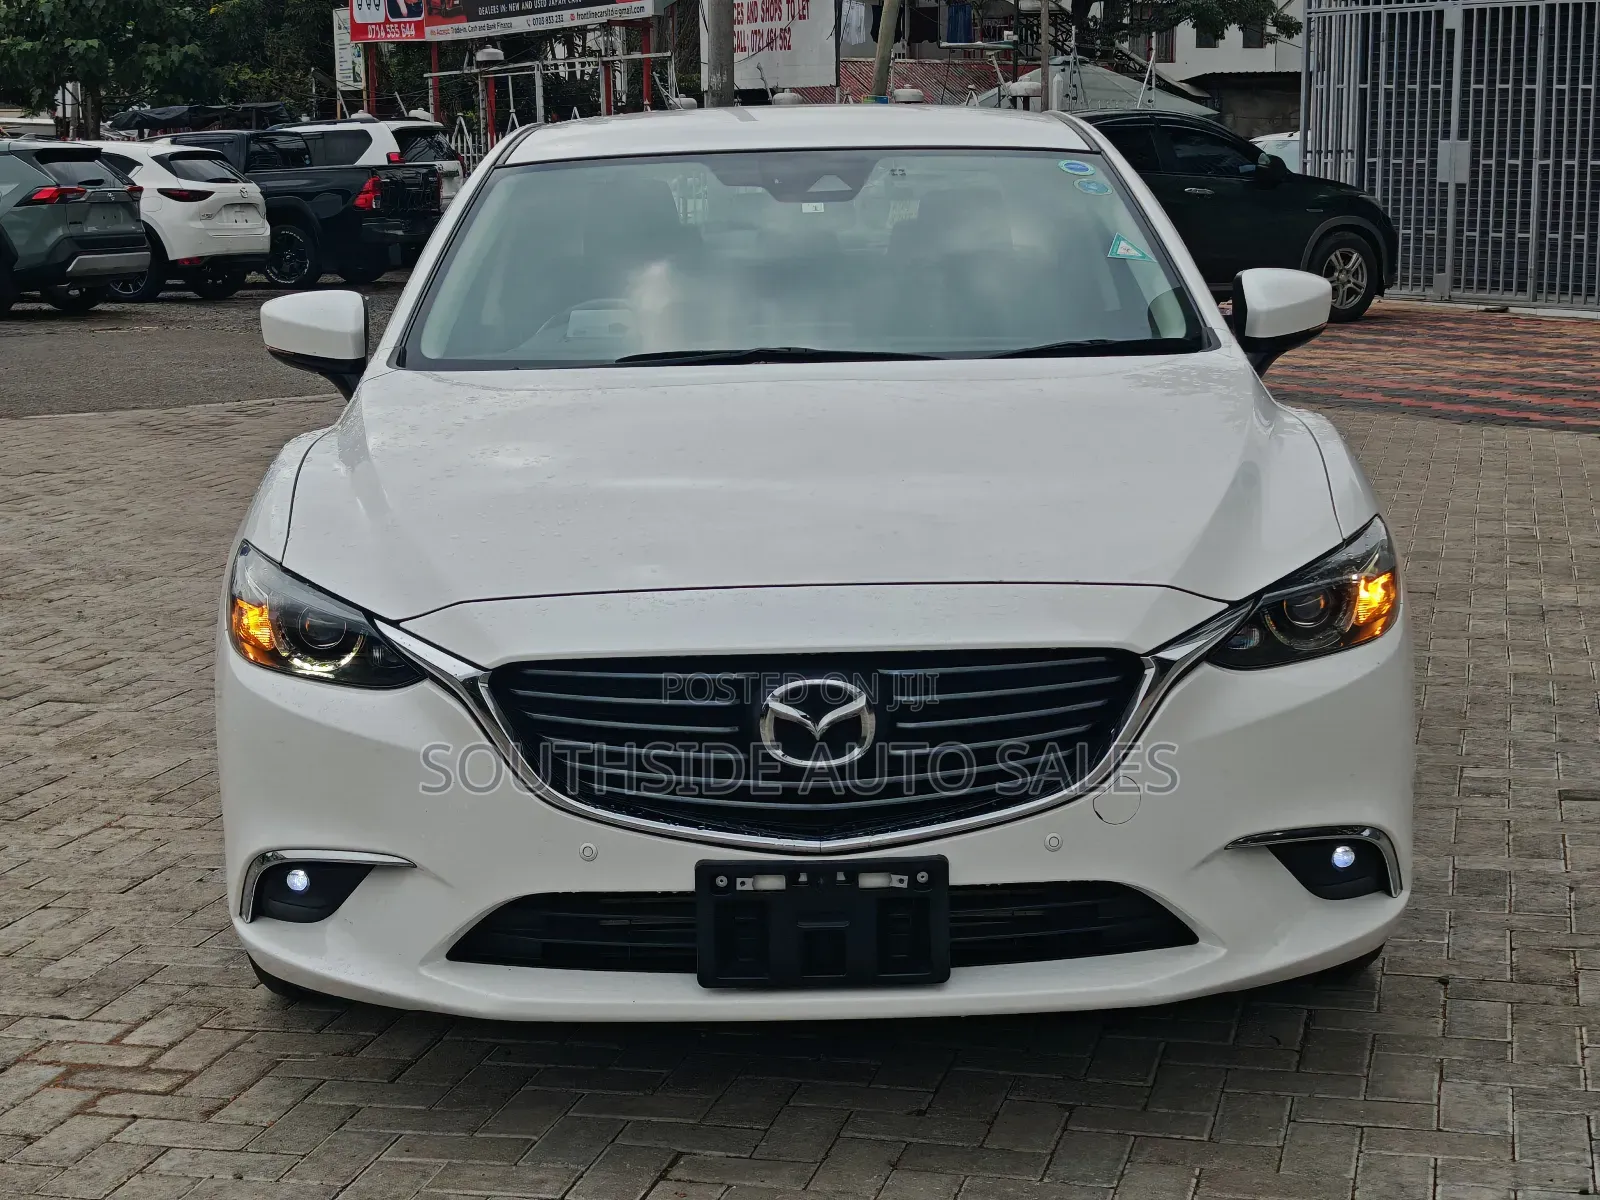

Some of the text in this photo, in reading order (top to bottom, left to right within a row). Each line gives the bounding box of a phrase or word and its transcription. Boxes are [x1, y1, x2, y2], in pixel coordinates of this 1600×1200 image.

[479, 5, 499, 16] DEALERS
[508, 2, 520, 11] NEW
[522, 1, 532, 10] AND
[534, 0, 546, 8] USED
[747, 1, 758, 24] AND
[761, 0, 783, 23] SHOPS
[786, 0, 795, 21] TO
[798, 0, 810, 20] LET
[486, 22, 496, 30] Bank
[751, 29, 764, 52] 0721
